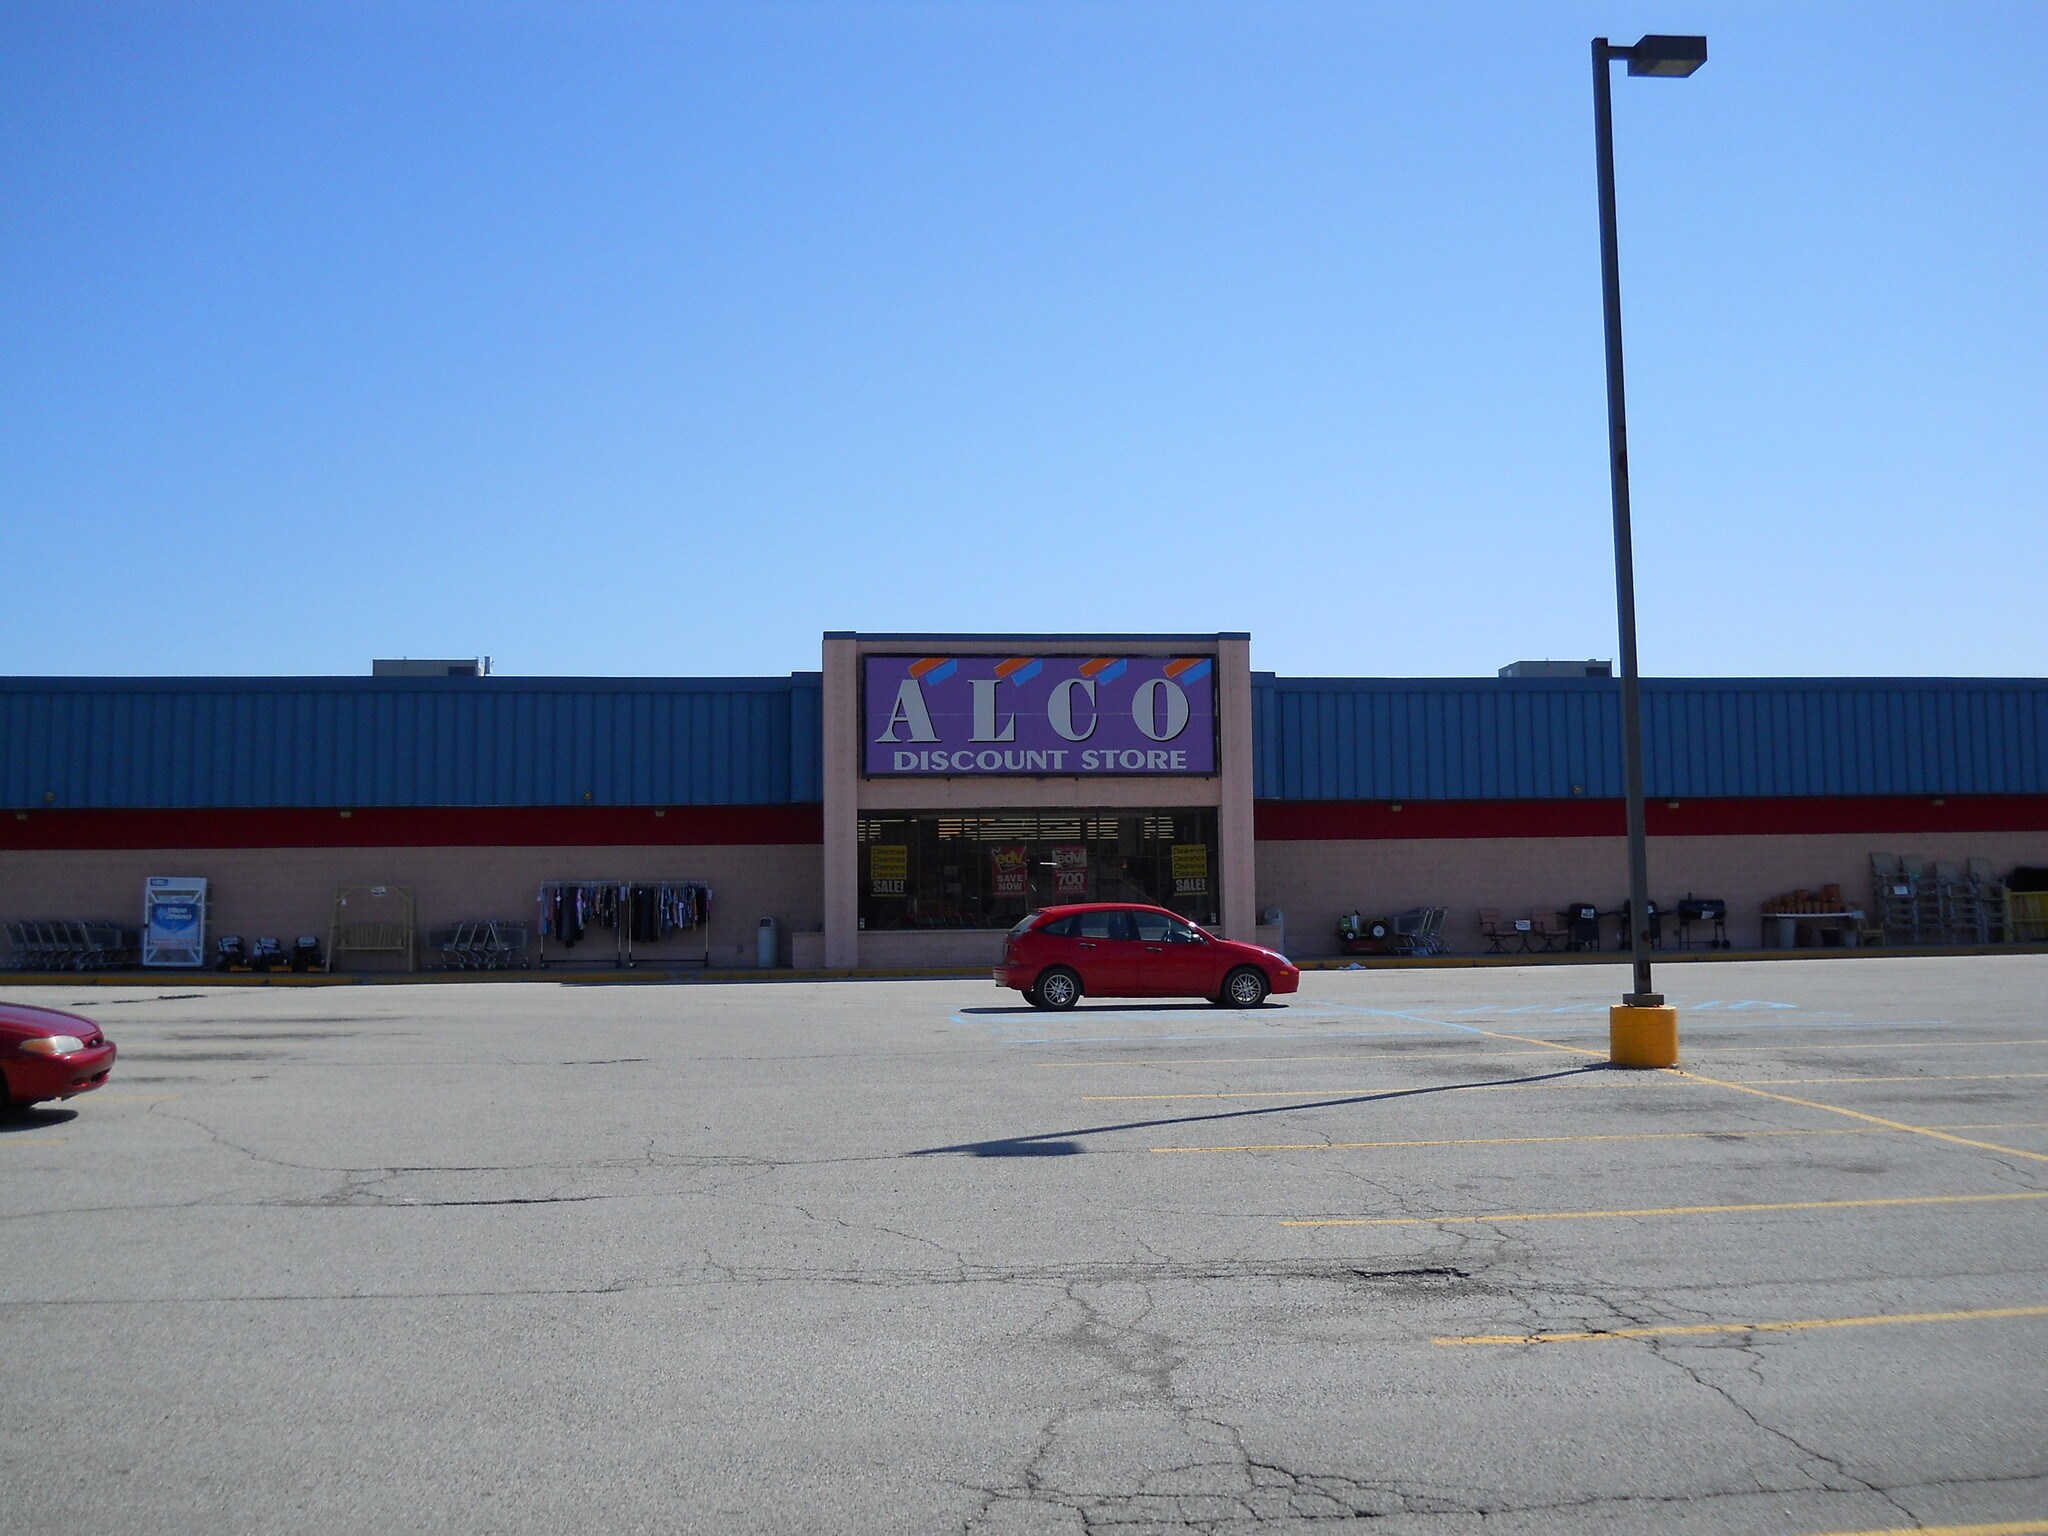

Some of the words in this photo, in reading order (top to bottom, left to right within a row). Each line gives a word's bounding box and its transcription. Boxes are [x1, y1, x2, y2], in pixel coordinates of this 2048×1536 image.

[875, 678, 1189, 742] ALCO
[893, 750, 1068, 771] DISCOUNT
[1081, 750, 1187, 770] STORE
[996, 874, 1023, 882] SAVE
[1175, 878, 1205, 891] SALE!
[873, 880, 905, 893] SALE!
[998, 882, 1022, 890] NOW
